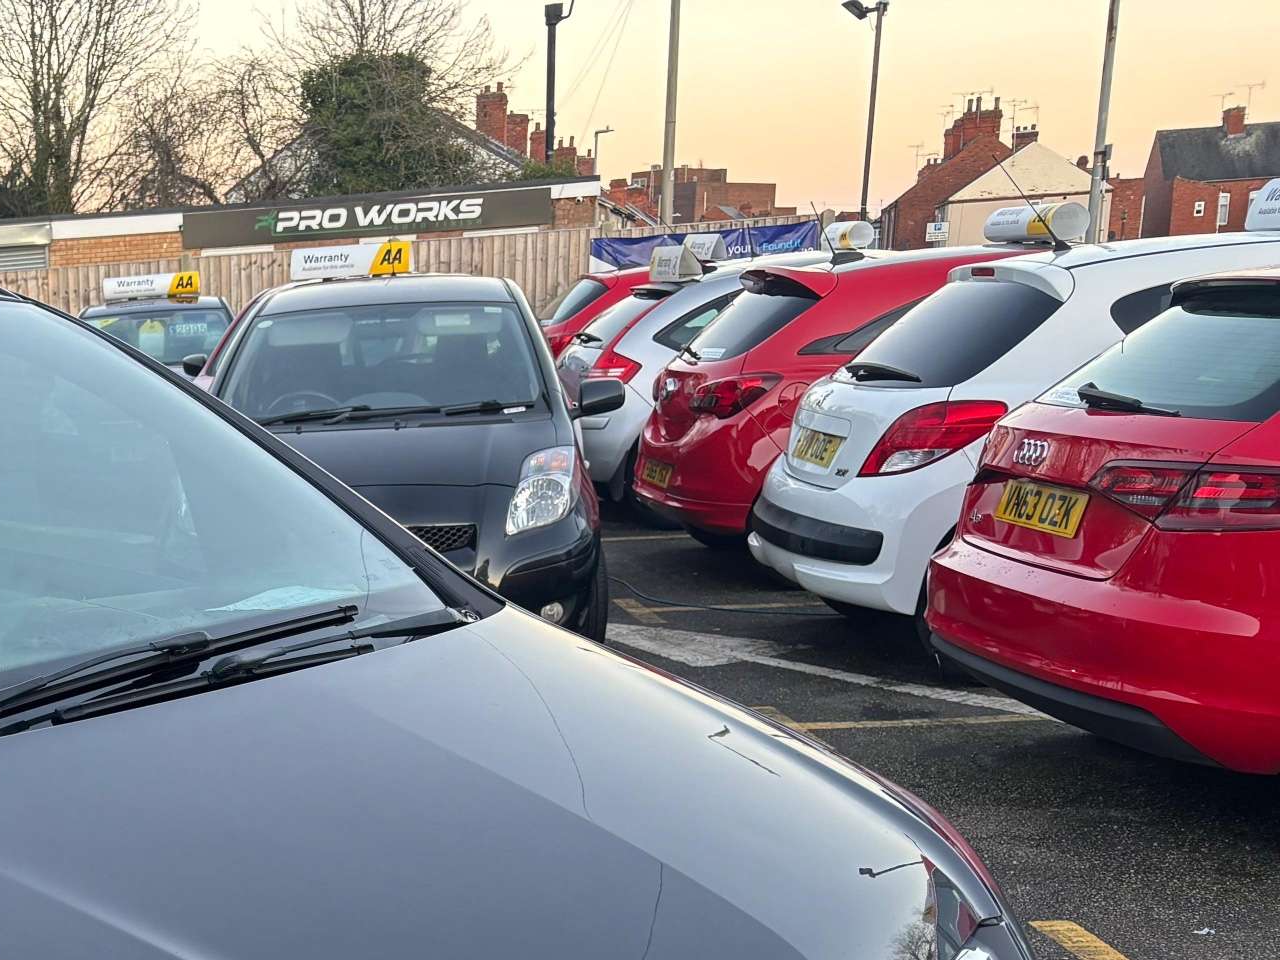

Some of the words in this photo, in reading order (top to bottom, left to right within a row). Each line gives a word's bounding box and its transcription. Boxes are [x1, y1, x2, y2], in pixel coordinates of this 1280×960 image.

[275, 207, 348, 233] PRO
[354, 197, 484, 227] WORKS
[303, 253, 350, 265] Warranty
[380, 248, 402, 265] AA
[116, 278, 154, 288] Warranty
[176, 275, 193, 289] AA
